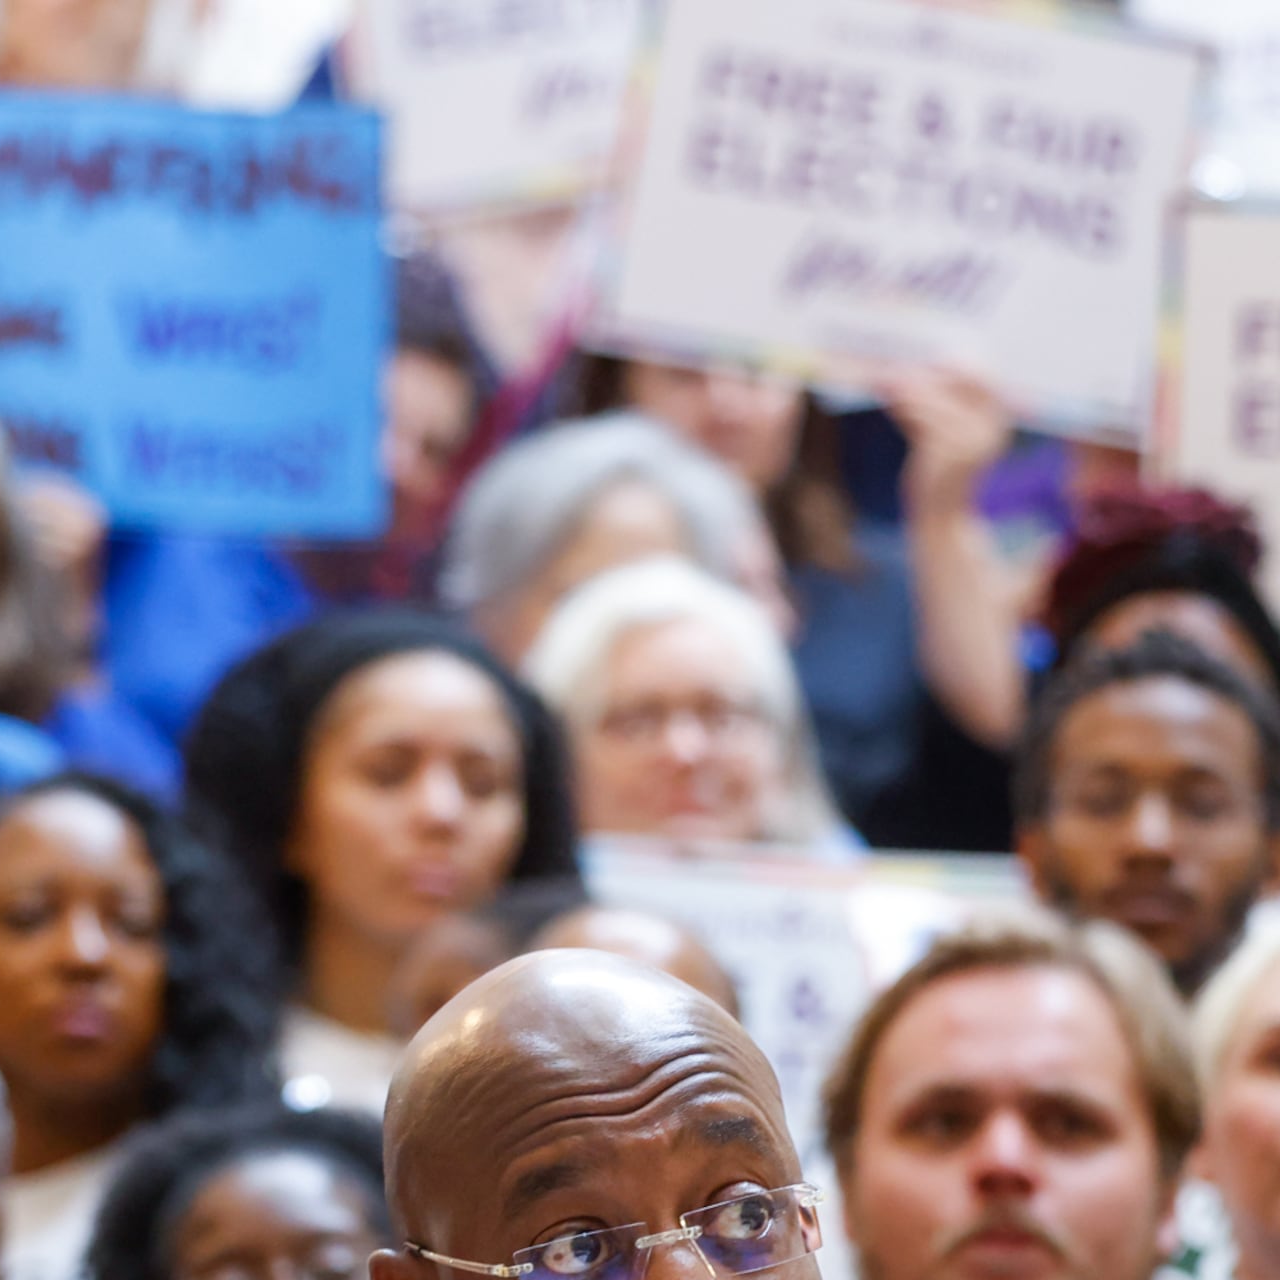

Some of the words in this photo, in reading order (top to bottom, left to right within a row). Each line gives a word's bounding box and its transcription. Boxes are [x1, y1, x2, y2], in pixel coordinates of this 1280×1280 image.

[702, 42, 883, 128] FREE
[913, 82, 950, 142] &
[983, 94, 1140, 176] FAIR
[682, 116, 1126, 264] ELECTIONS
